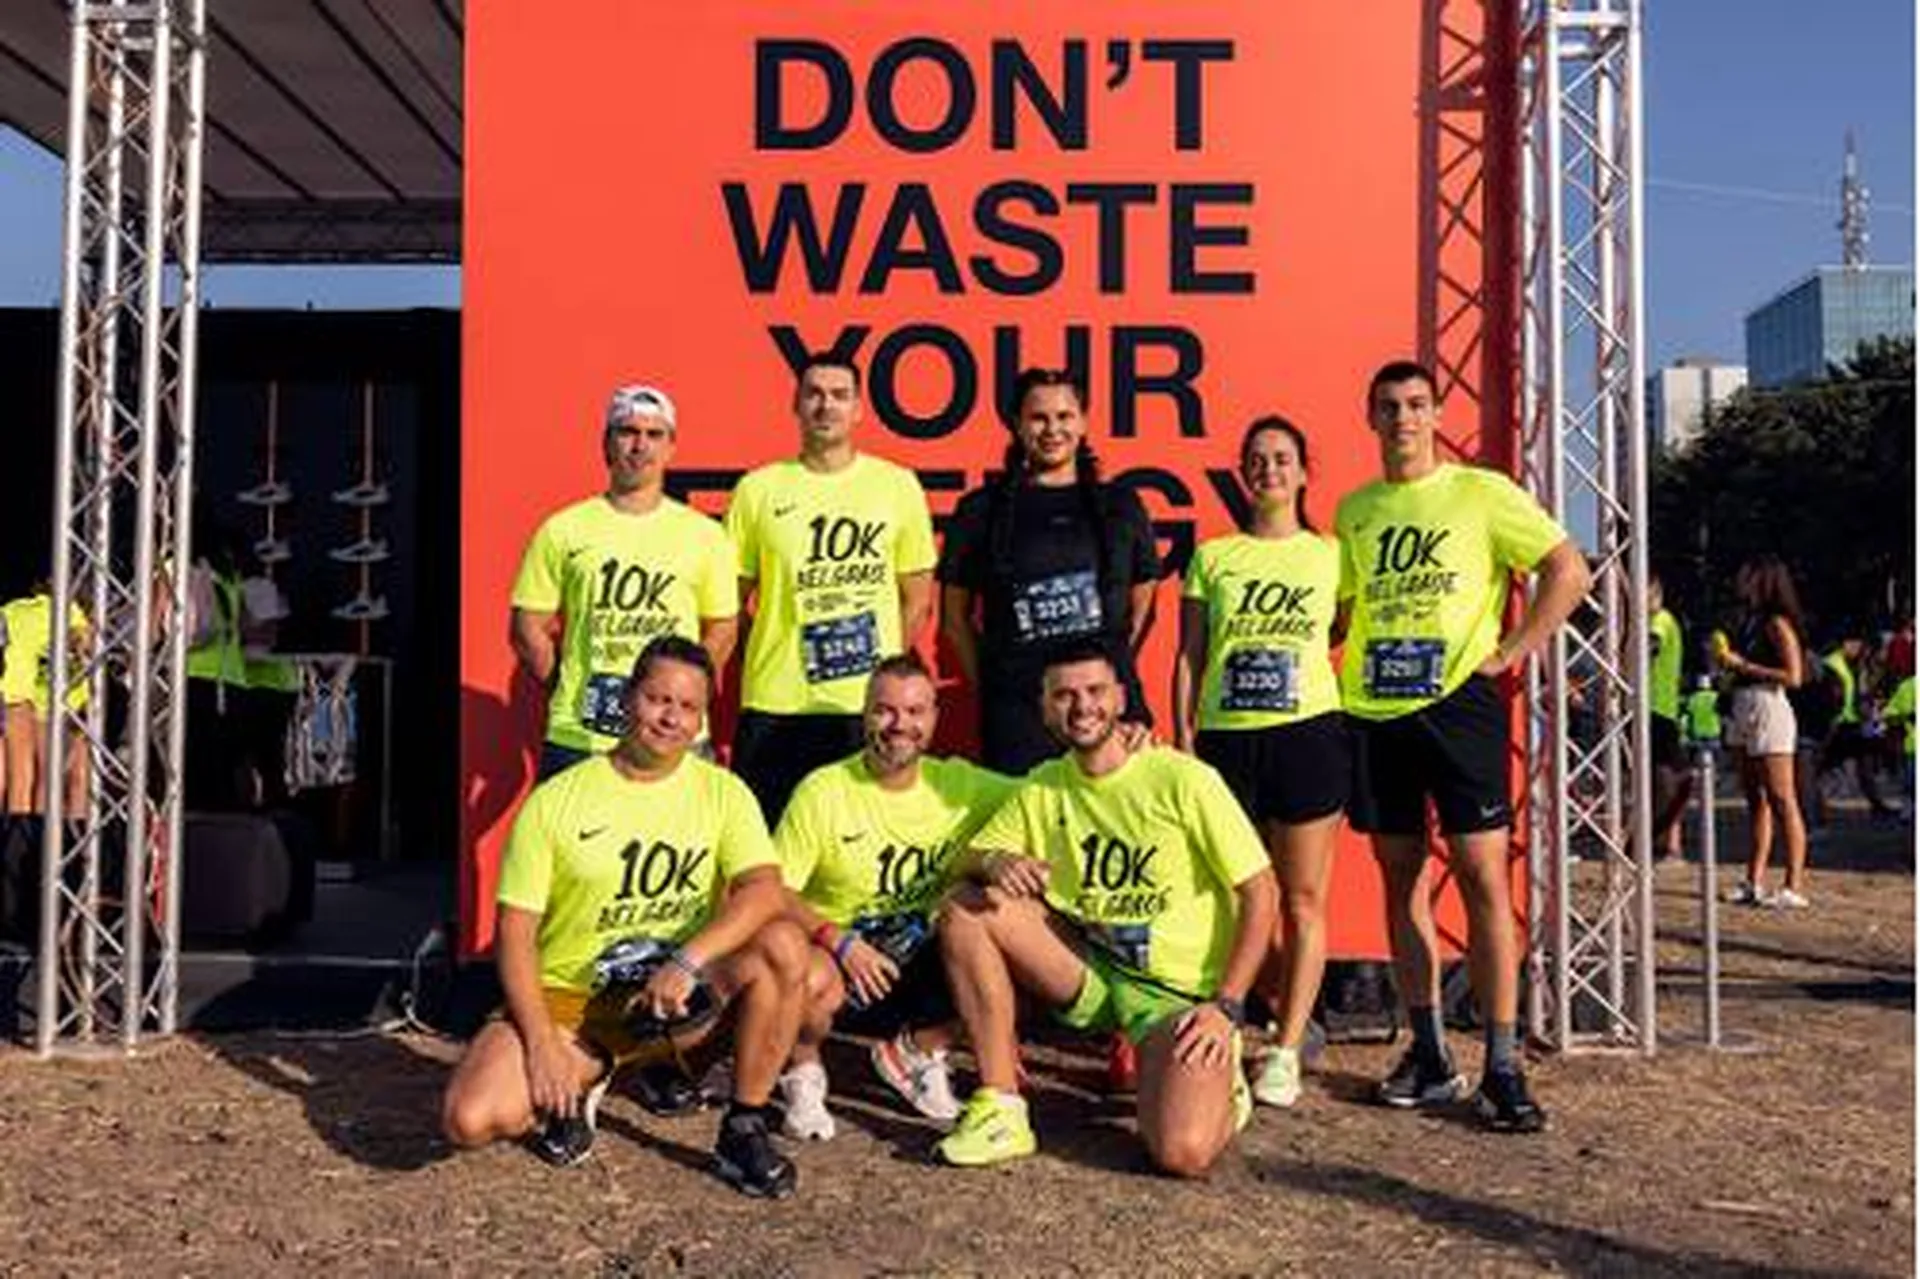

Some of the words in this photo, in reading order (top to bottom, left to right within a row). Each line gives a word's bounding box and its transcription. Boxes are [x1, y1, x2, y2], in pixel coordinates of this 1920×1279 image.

[755, 37, 1235, 153] DON'T
[721, 180, 1256, 296] WASTE
[807, 514, 886, 563] 10K
[1373, 526, 1450, 576] 10K
[595, 557, 676, 612] 10K
[1235, 580, 1315, 616] 10K
[614, 839, 710, 900] 10K
[1080, 832, 1158, 890] 10K
